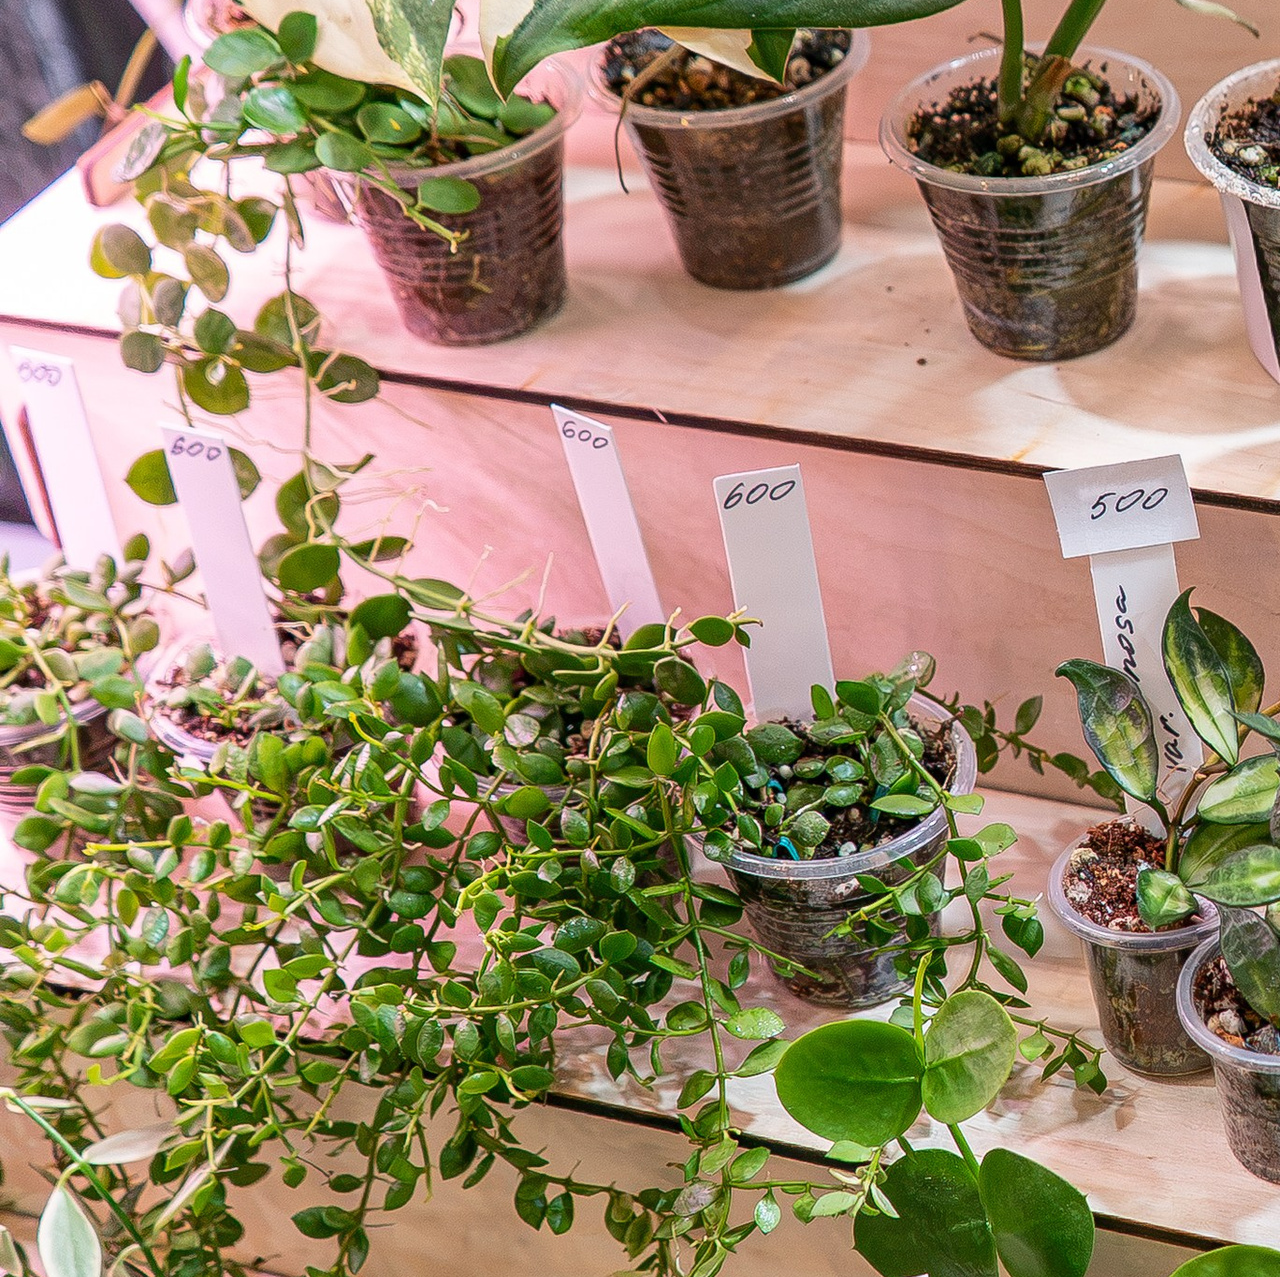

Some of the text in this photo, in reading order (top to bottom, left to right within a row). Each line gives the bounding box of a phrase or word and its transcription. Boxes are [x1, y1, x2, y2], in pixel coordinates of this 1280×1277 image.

[171, 436, 222, 461] 600
[562, 420, 609, 449] 600
[723, 479, 796, 510] 600
[1090, 487, 1170, 521] 500
